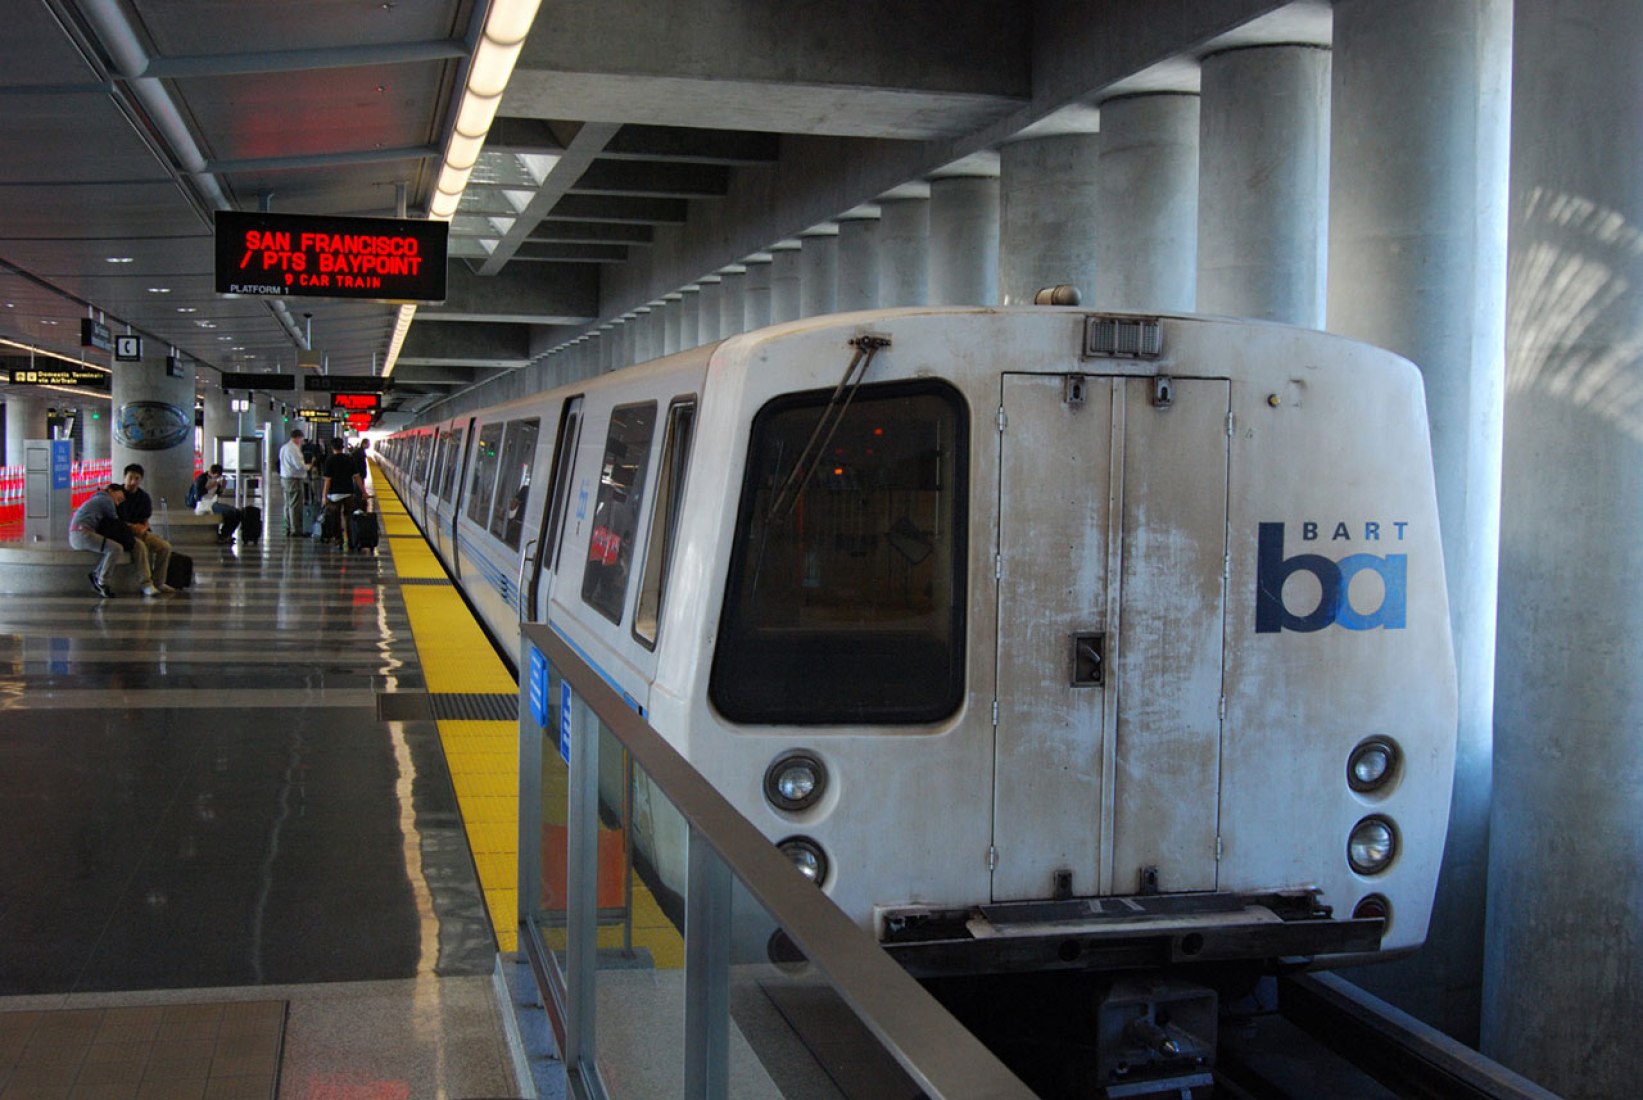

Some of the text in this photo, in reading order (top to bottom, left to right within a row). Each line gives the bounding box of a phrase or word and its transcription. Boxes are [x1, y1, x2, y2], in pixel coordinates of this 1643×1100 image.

[245, 230, 418, 257] SAN FRANCISCO
[240, 250, 422, 276] / PTS BAYPOINT
[230, 284, 289, 295] PLATFORM 1
[285, 273, 381, 289] 9 CAR TRAIN
[1302, 521, 1409, 541] BART
[1255, 521, 1408, 633] ba
